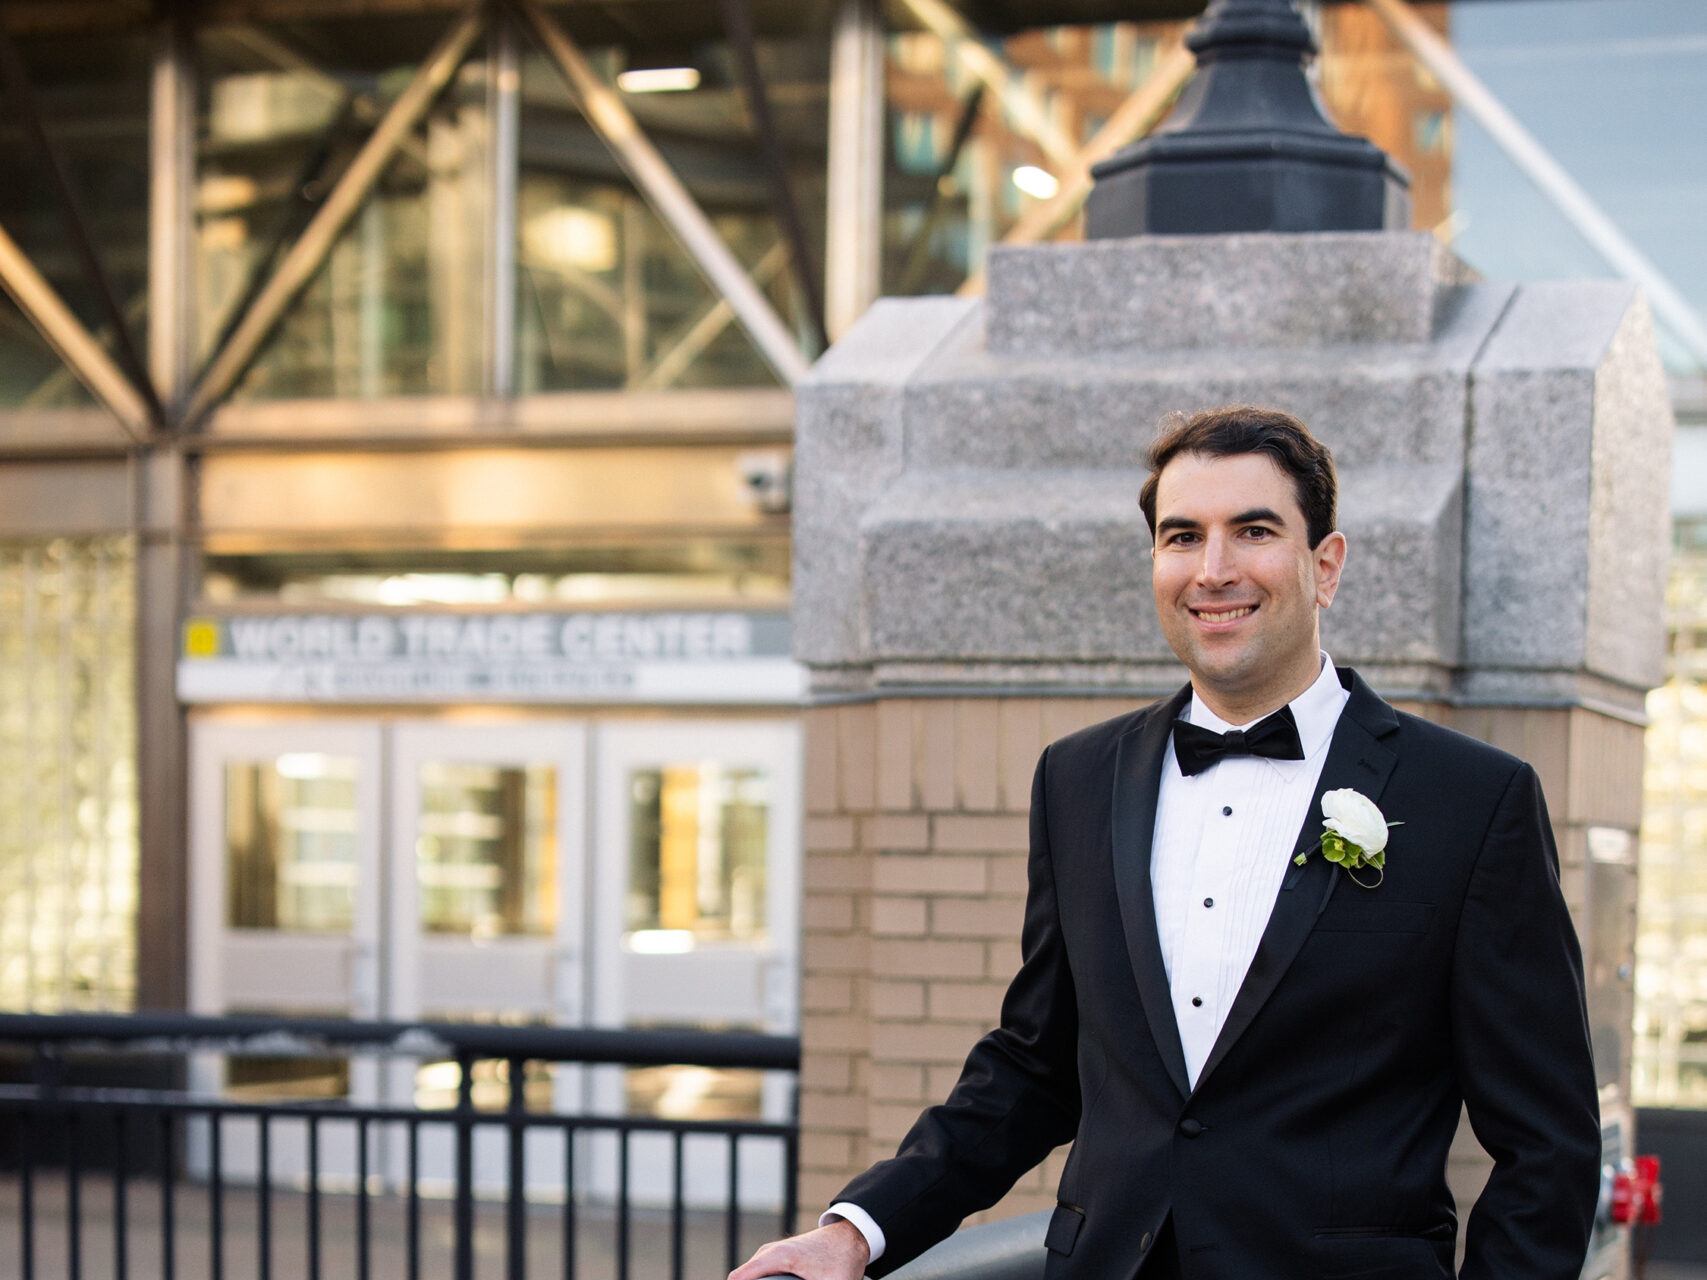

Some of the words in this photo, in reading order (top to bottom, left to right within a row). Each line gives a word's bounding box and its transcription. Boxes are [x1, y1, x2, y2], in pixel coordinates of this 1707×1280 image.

[230, 617, 393, 659] WORLD
[403, 615, 550, 659] TRADE
[560, 613, 750, 658] CENTER
